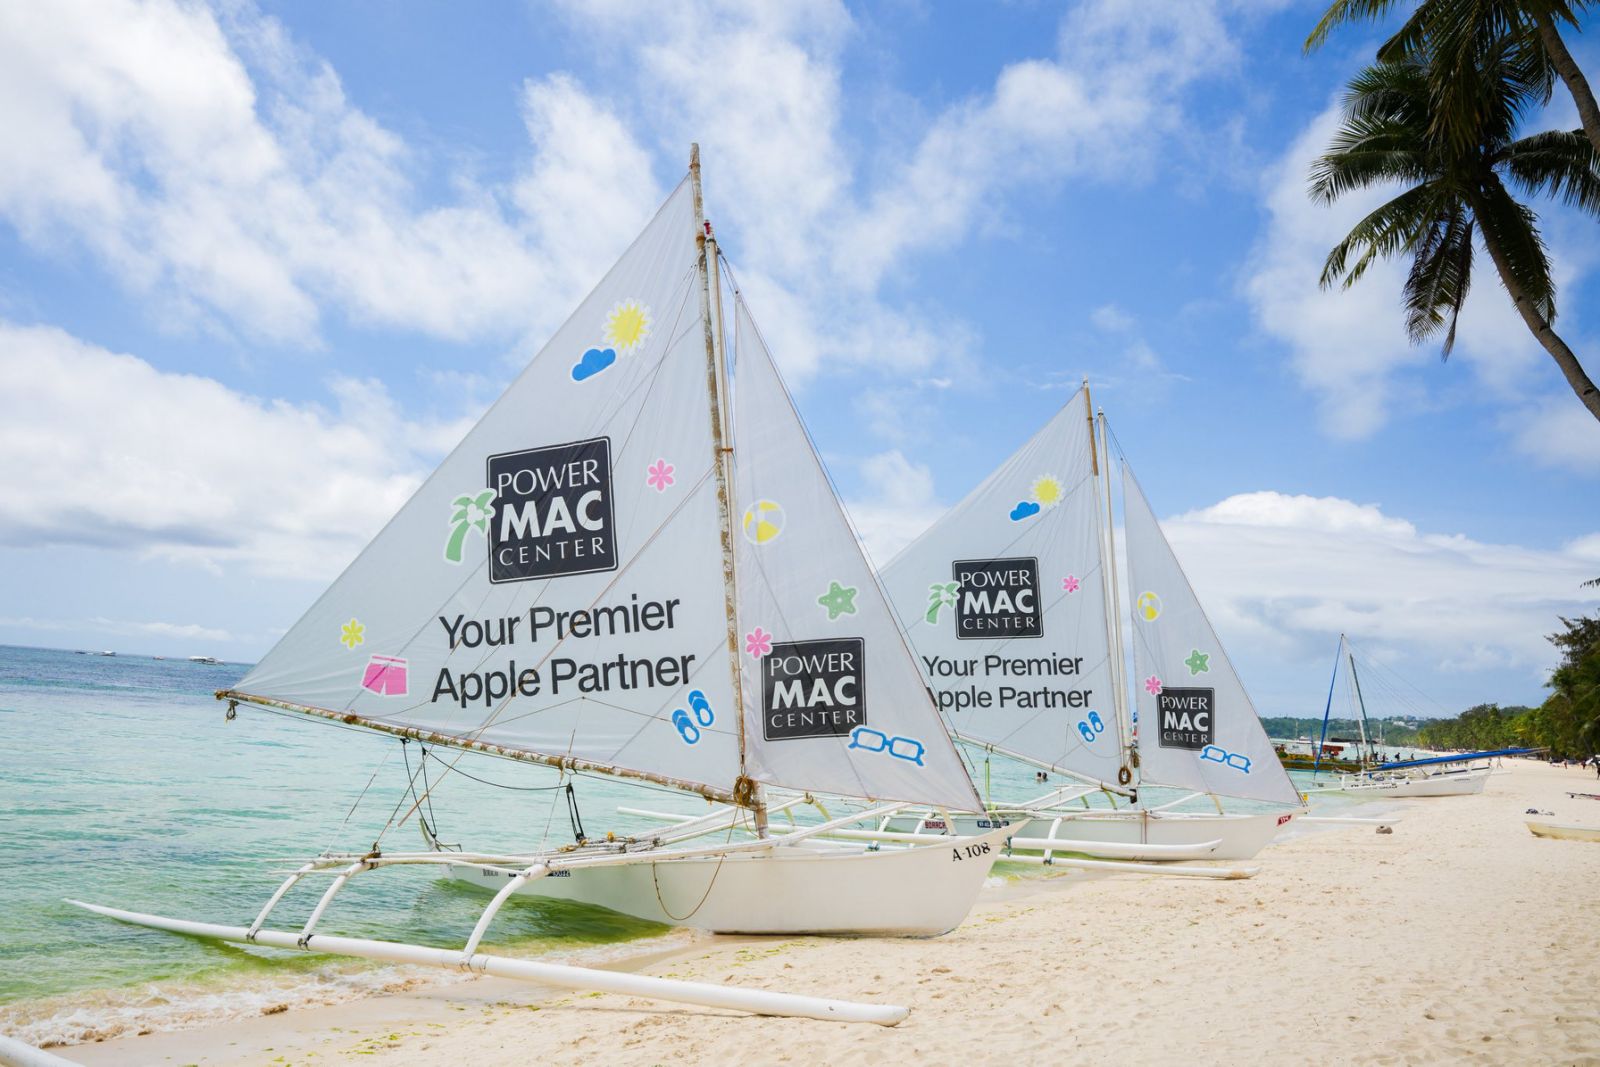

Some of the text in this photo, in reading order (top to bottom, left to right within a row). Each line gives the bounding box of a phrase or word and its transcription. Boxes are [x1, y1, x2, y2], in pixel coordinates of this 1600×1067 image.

[497, 459, 600, 498] POWER
[500, 490, 604, 542] MAC
[499, 537, 605, 566] CENTER
[960, 569, 1032, 588] POWER
[963, 588, 1034, 615] MAC
[439, 593, 680, 649] Your Premier
[963, 616, 1035, 630] CENTER
[770, 652, 855, 676] POWER
[922, 652, 1083, 677] Your Premier
[431, 653, 696, 708] Apple Partner
[771, 675, 856, 710] MAC
[999, 686, 1092, 708] Partner
[1161, 696, 1208, 709] POWER
[771, 709, 857, 728] CENTER
[1164, 711, 1209, 731] MAC
[1164, 731, 1208, 743] CENTER
[952, 842, 991, 861] A-108
